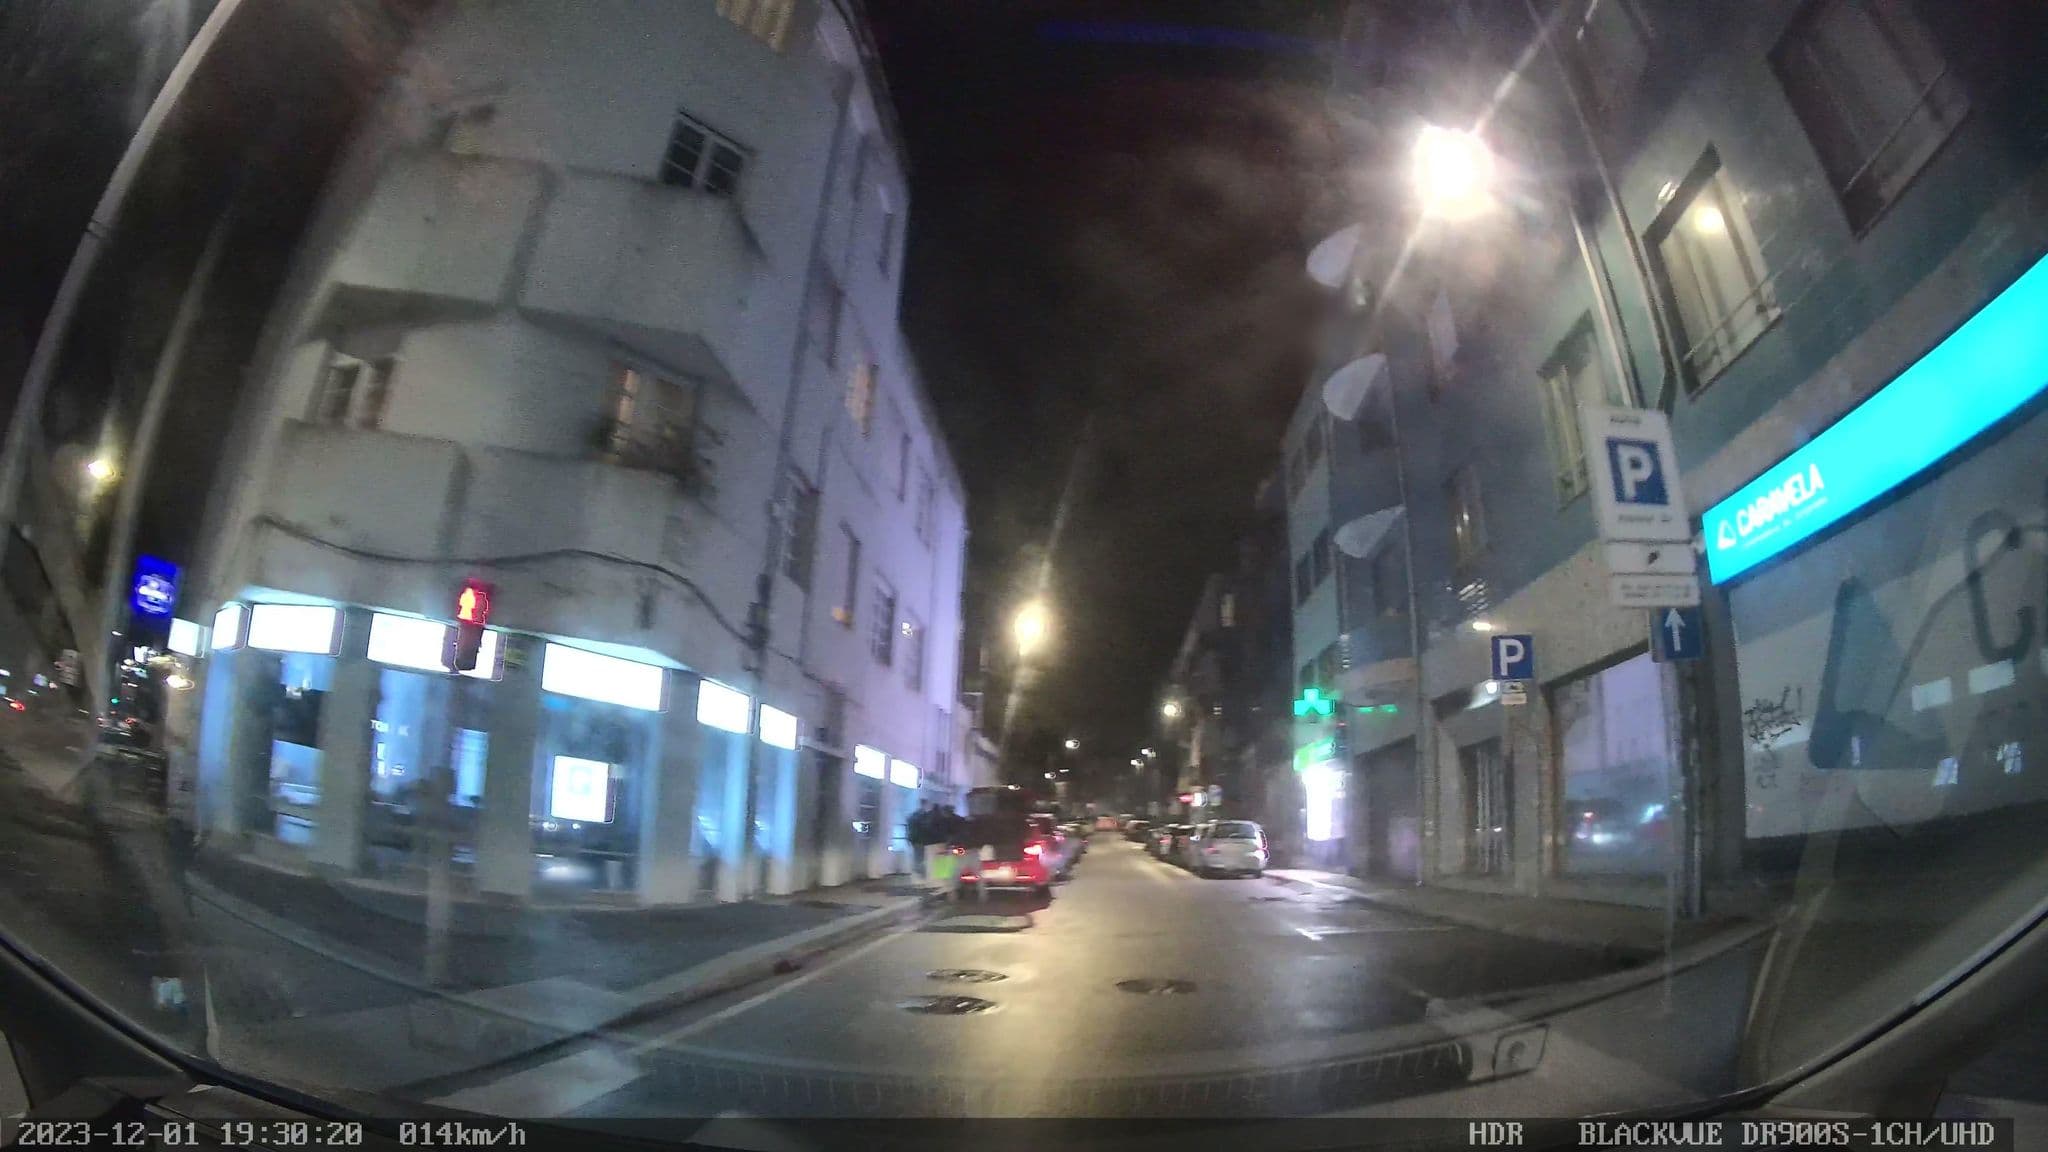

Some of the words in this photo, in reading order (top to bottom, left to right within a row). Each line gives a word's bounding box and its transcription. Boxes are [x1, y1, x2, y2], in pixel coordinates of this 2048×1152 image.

[1616, 444, 1654, 501] P
[1736, 463, 1825, 537] CARAVELA
[1499, 638, 1525, 677] P
